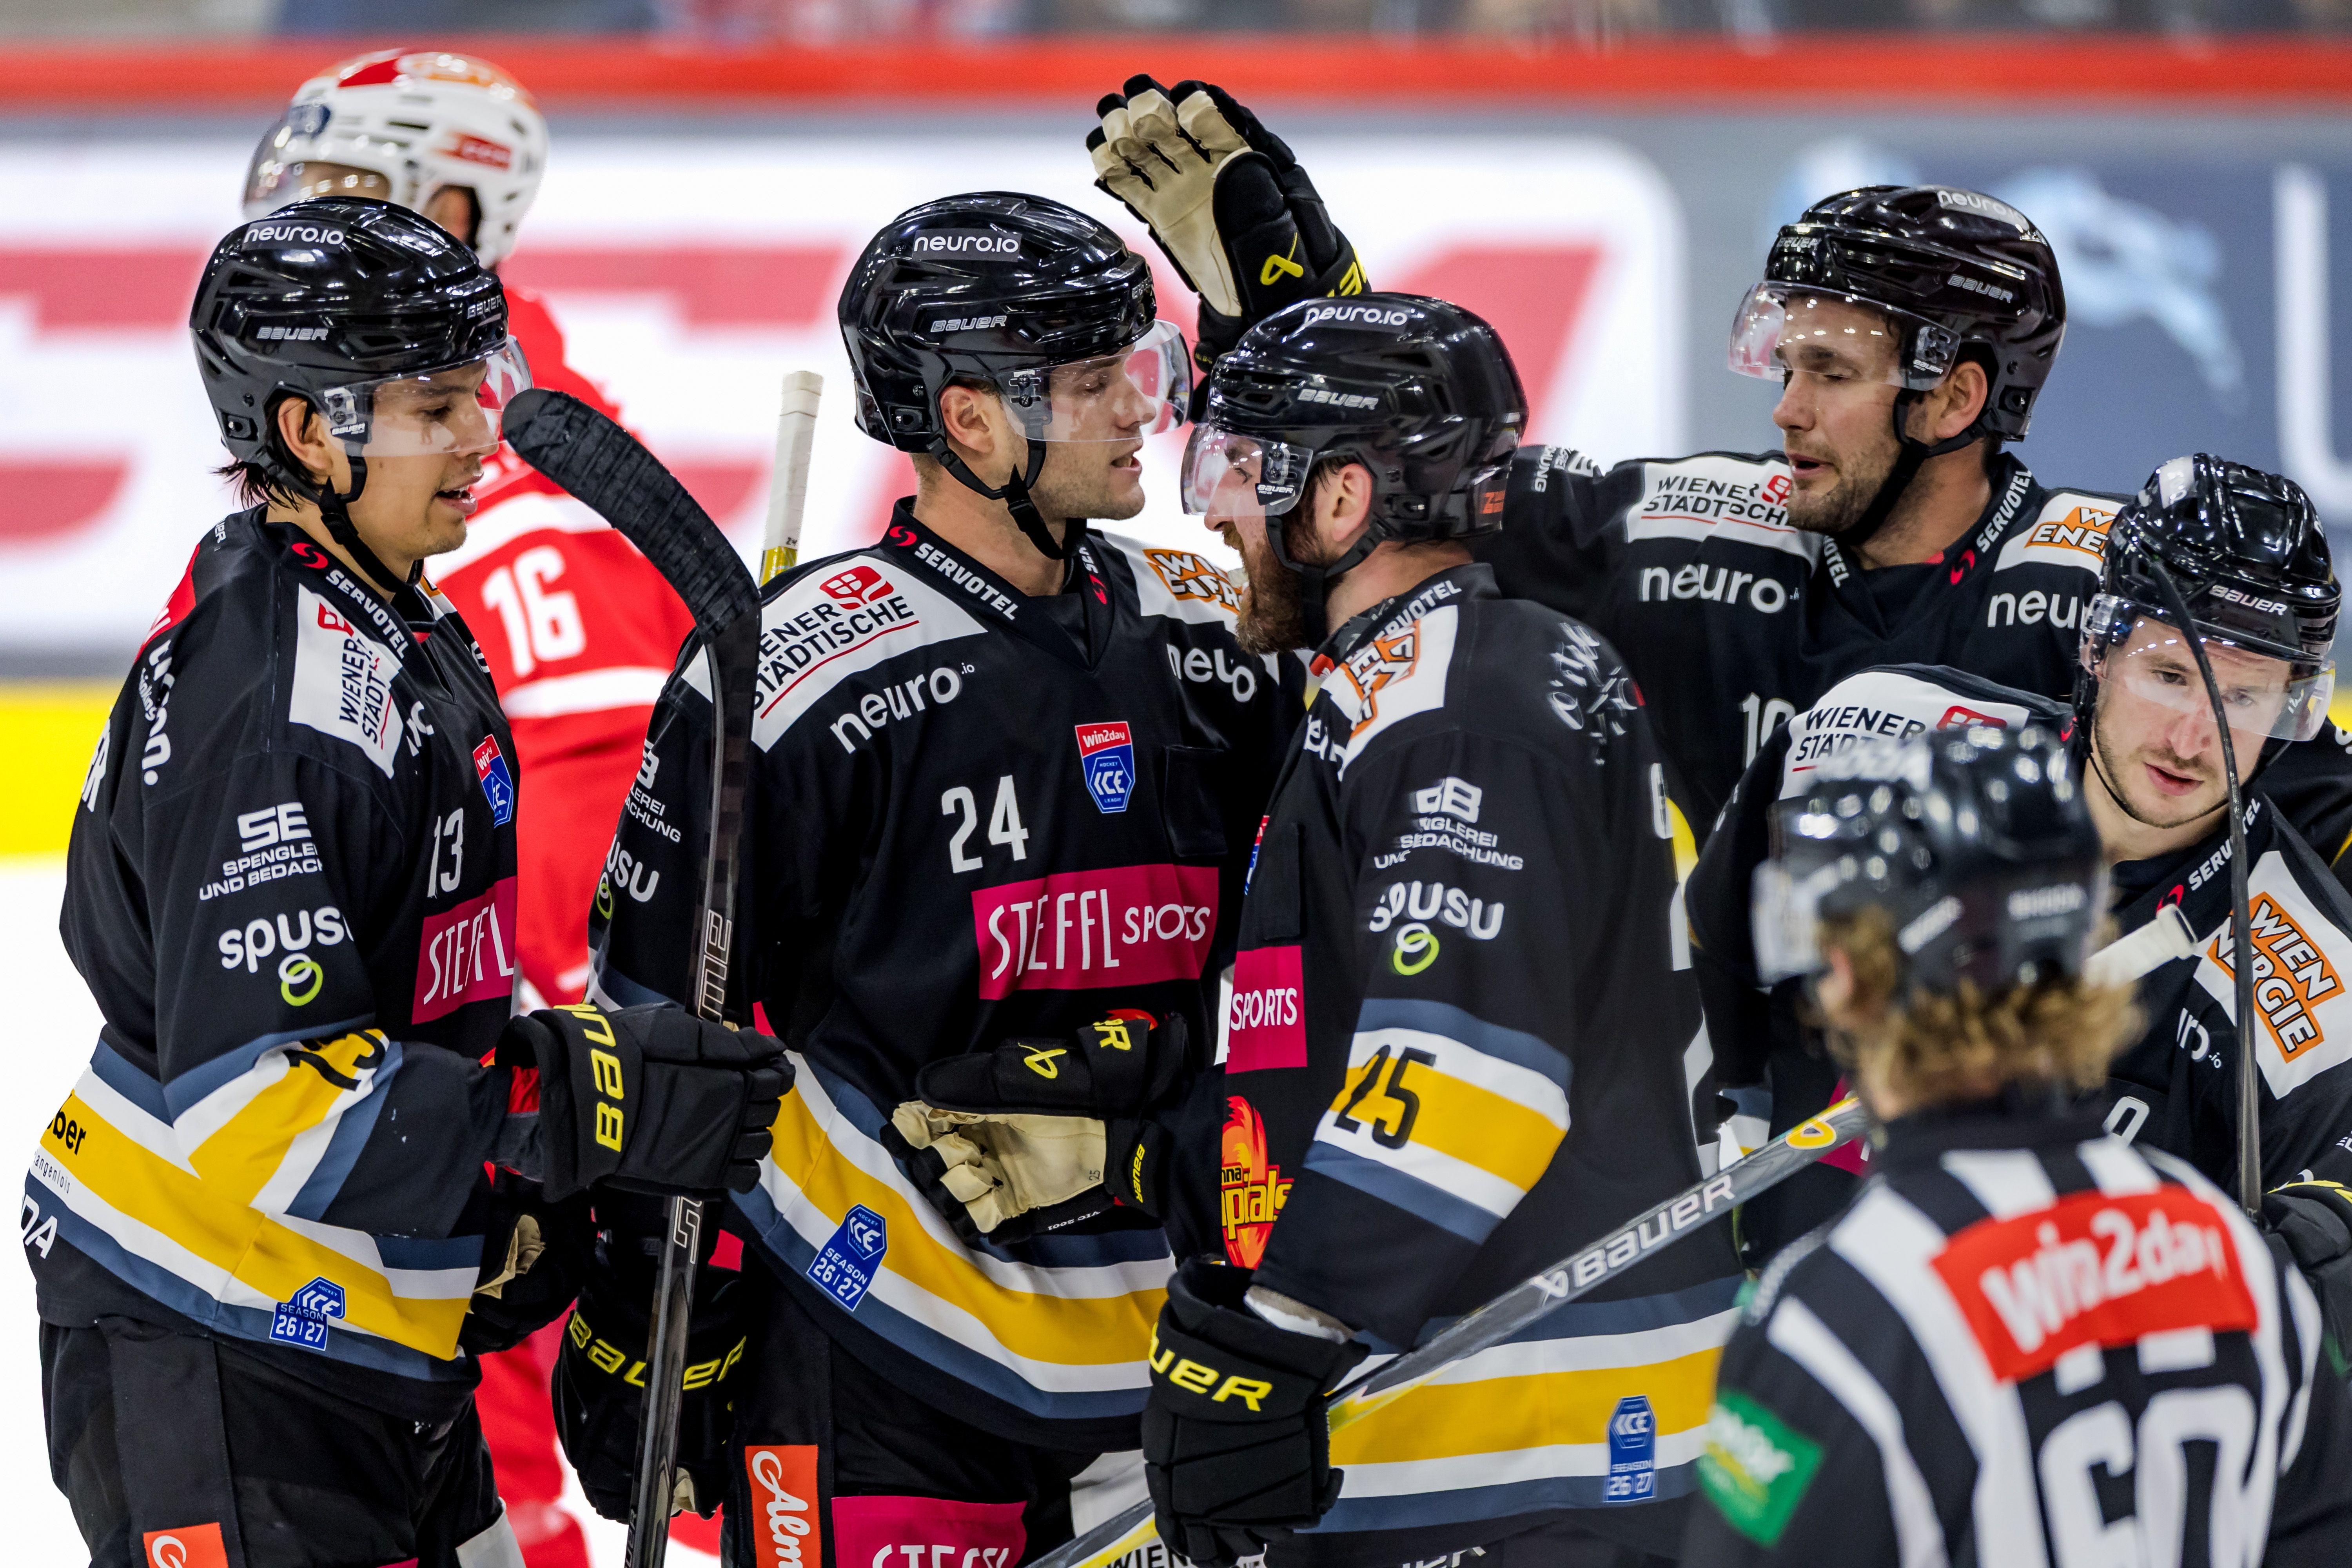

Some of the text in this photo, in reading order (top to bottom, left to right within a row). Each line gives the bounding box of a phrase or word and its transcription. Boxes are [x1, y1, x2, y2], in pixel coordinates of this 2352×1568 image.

[914, 235, 1019, 253] neuro.io
[1948, 274, 2013, 303] BAUER
[257, 326, 328, 341] BAUER
[930, 315, 1007, 332] BAUER
[1298, 388, 1379, 410] BAUER
[914, 543, 1018, 621] SERVOTEL
[2208, 584, 2287, 616] BAUER
[325, 569, 409, 659] SERVOTEL
[481, 545, 587, 677] 16
[1987, 590, 2082, 630] neu
[759, 603, 841, 663] ENER
[1094, 770, 1125, 795] ICE
[942, 775, 1029, 874] 24
[223, 844, 318, 877] SPENGLE
[427, 808, 463, 899] 13
[2188, 799, 2260, 891] SERVTEL
[199, 877, 244, 900] UND
[988, 888, 1120, 980] STEFFL
[2250, 902, 2336, 1001] WIEN
[1230, 987, 1298, 1031] SPORTS
[1334, 1044, 1436, 1151] 25
[1132, 1144, 1146, 1204] BAUER
[849, 1216, 882, 1252] ICE
[858, 1212, 879, 1226] HOCKEY
[1573, 1174, 1735, 1289] BAUER
[825, 1248, 868, 1285] SEASON
[302, 1290, 341, 1315] ICE
[318, 1284, 338, 1297] HOCKEY
[280, 1303, 324, 1321] SEASON
[1149, 1320, 1273, 1411] UER
